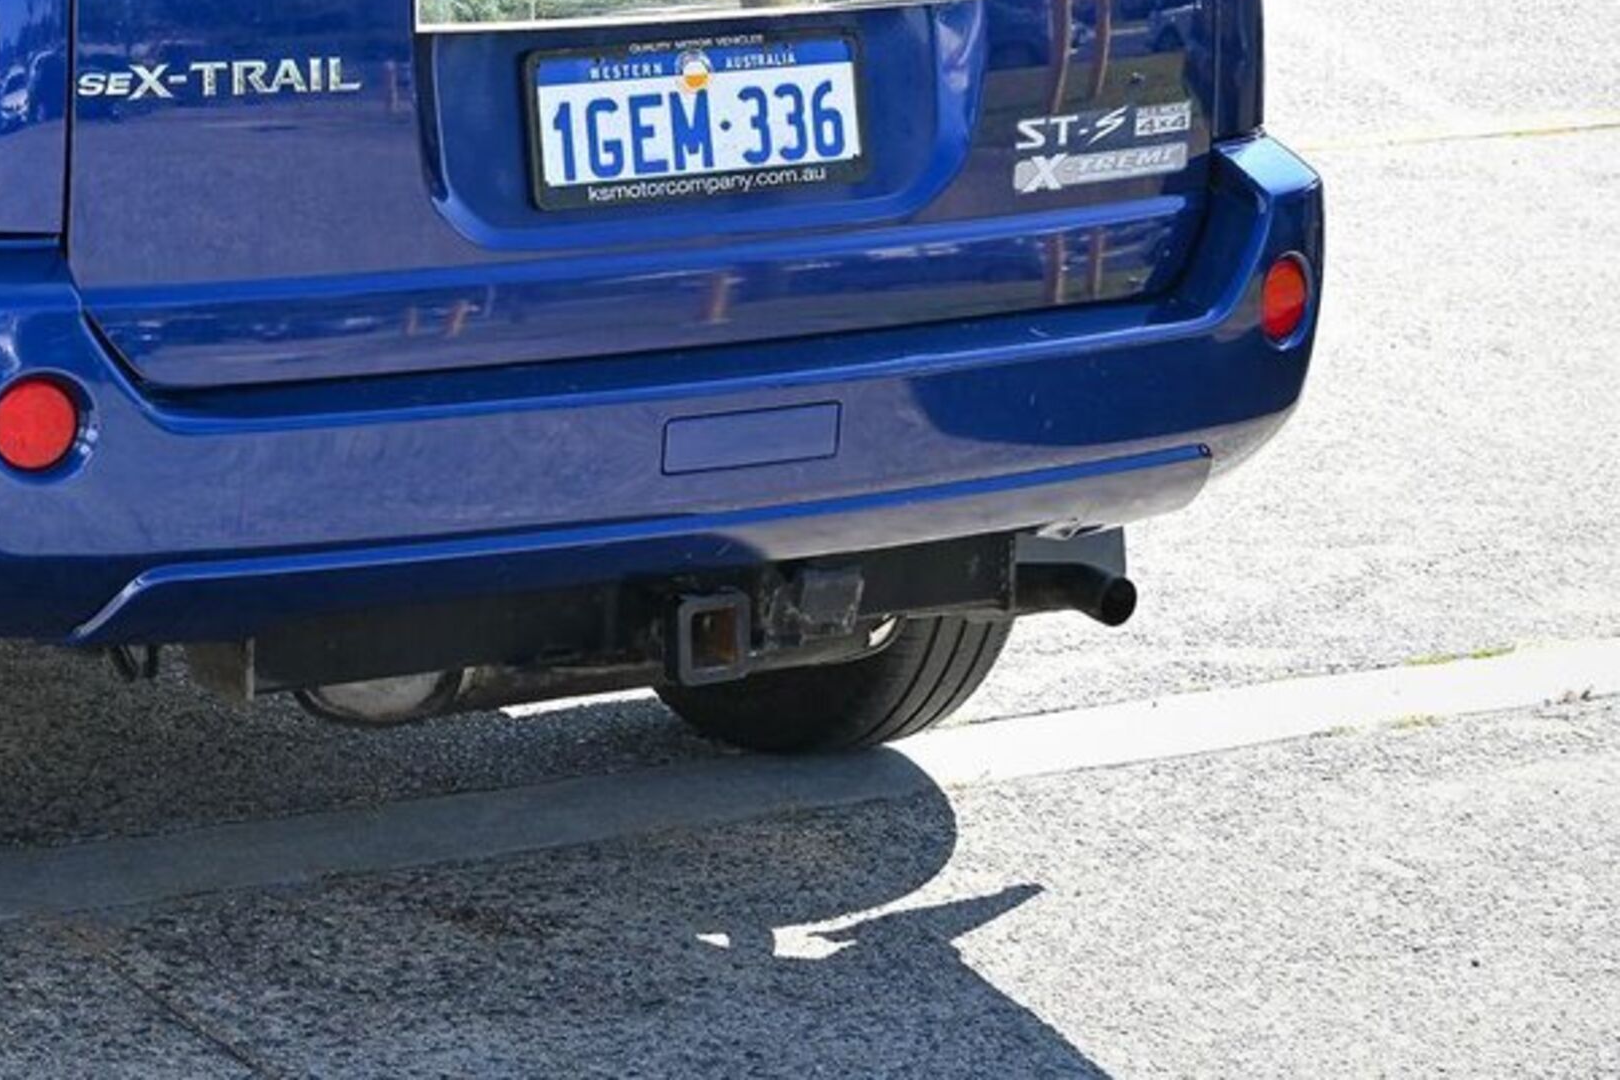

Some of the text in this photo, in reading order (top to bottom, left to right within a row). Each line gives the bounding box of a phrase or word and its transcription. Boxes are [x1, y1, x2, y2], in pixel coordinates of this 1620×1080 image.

[589, 52, 796, 80] WESTERN AUSTRALIA
[587, 166, 827, 203] ksmotorcompany.com.au
